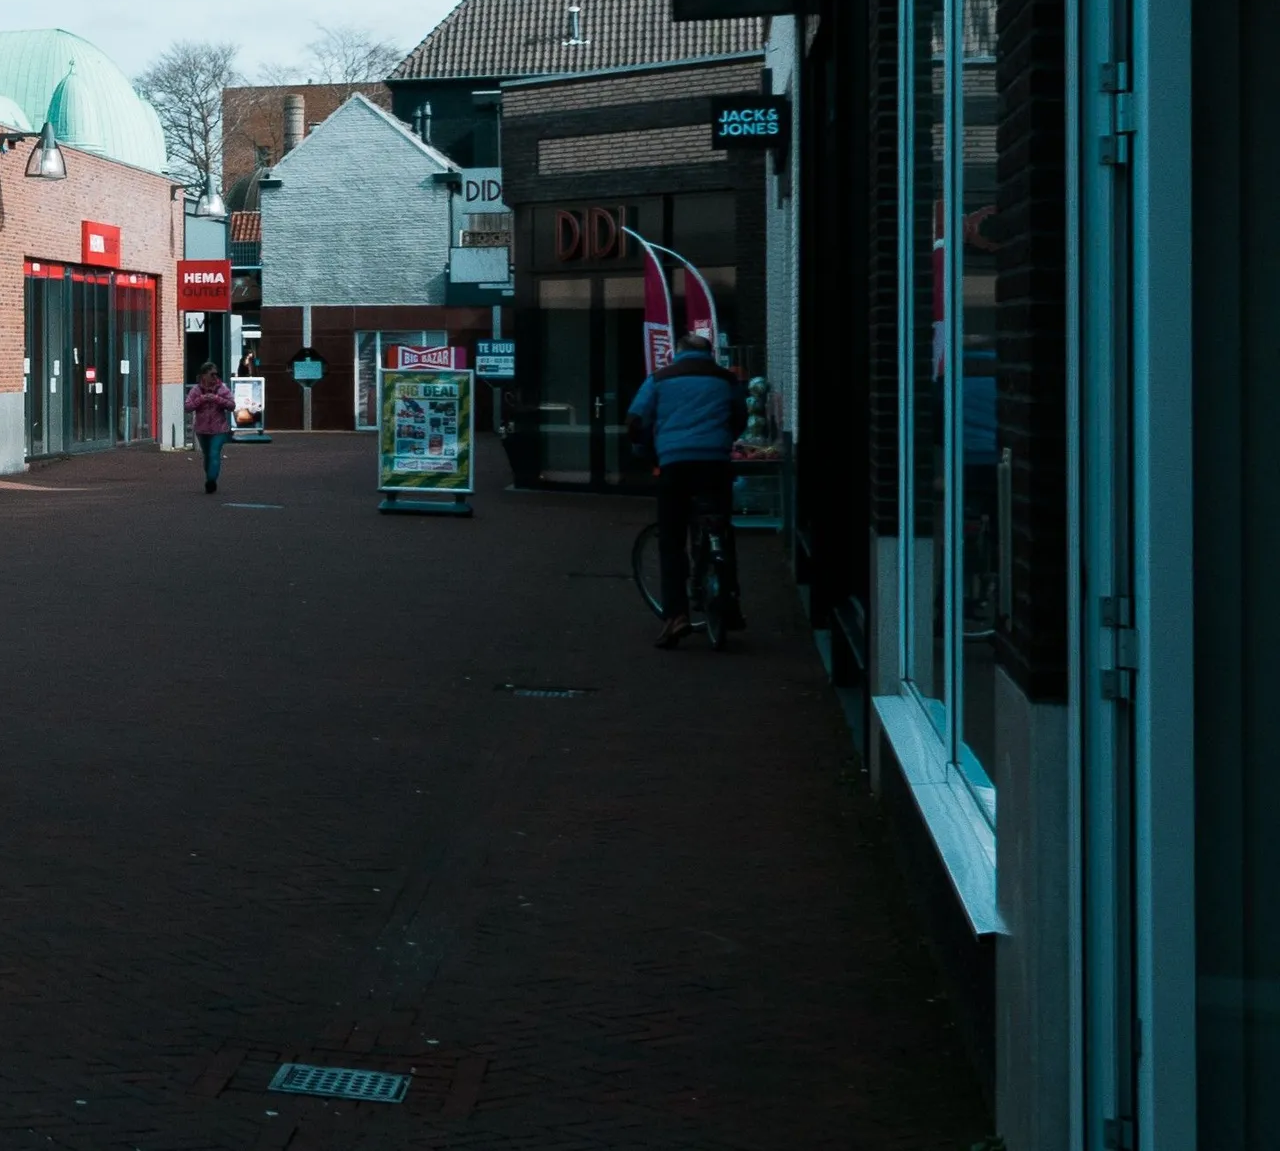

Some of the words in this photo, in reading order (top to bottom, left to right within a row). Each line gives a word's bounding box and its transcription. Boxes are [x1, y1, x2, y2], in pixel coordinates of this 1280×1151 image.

[719, 122, 779, 136] JONES
[555, 205, 627, 261] DIDI
[184, 272, 225, 284] HEMA
[183, 286, 227, 298] OUTLET
[477, 343, 489, 354] TE
[404, 351, 419, 364] BIG
[421, 350, 449, 365] BAZAR
[398, 385, 419, 397] BIG
[423, 385, 457, 398] DEAL
